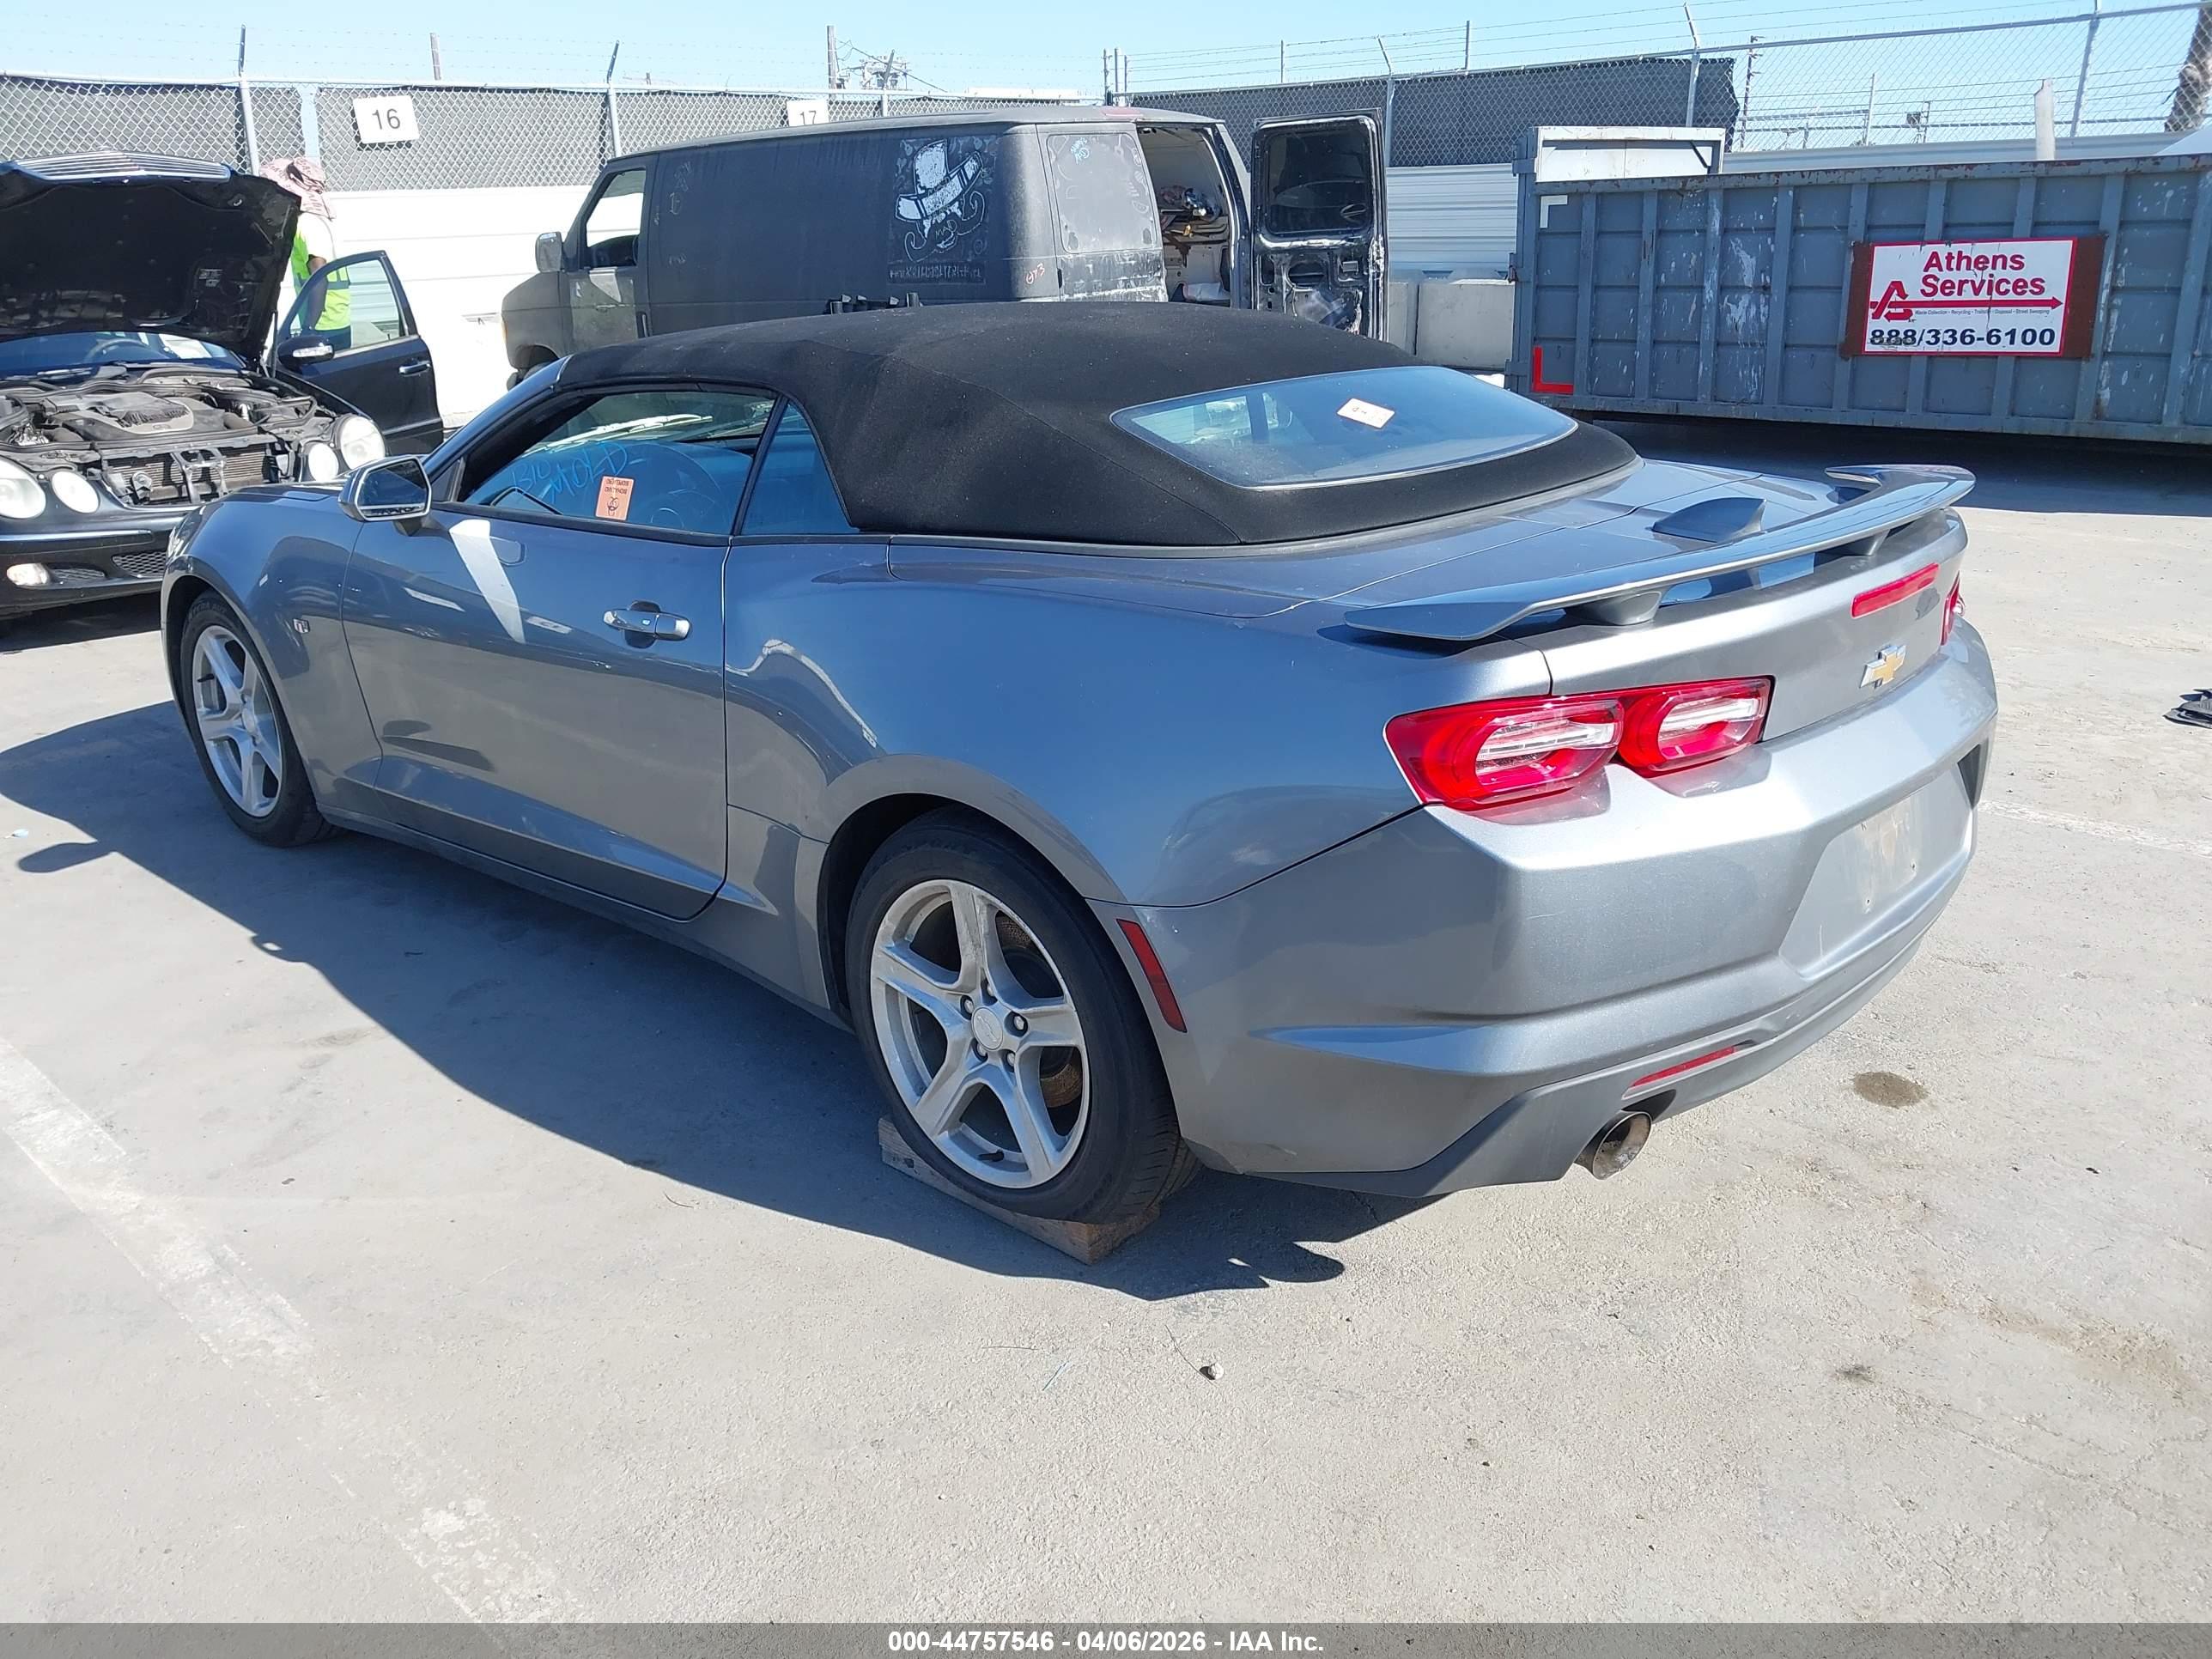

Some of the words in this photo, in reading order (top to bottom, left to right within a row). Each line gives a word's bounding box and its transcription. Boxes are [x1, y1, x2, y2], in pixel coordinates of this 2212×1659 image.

[372, 108, 401, 130] 16
[799, 110, 817, 125] 17
[1923, 250, 2026, 273] Athens
[1919, 273, 2046, 298] Services
[1869, 327, 2056, 346] 888/336-6100
